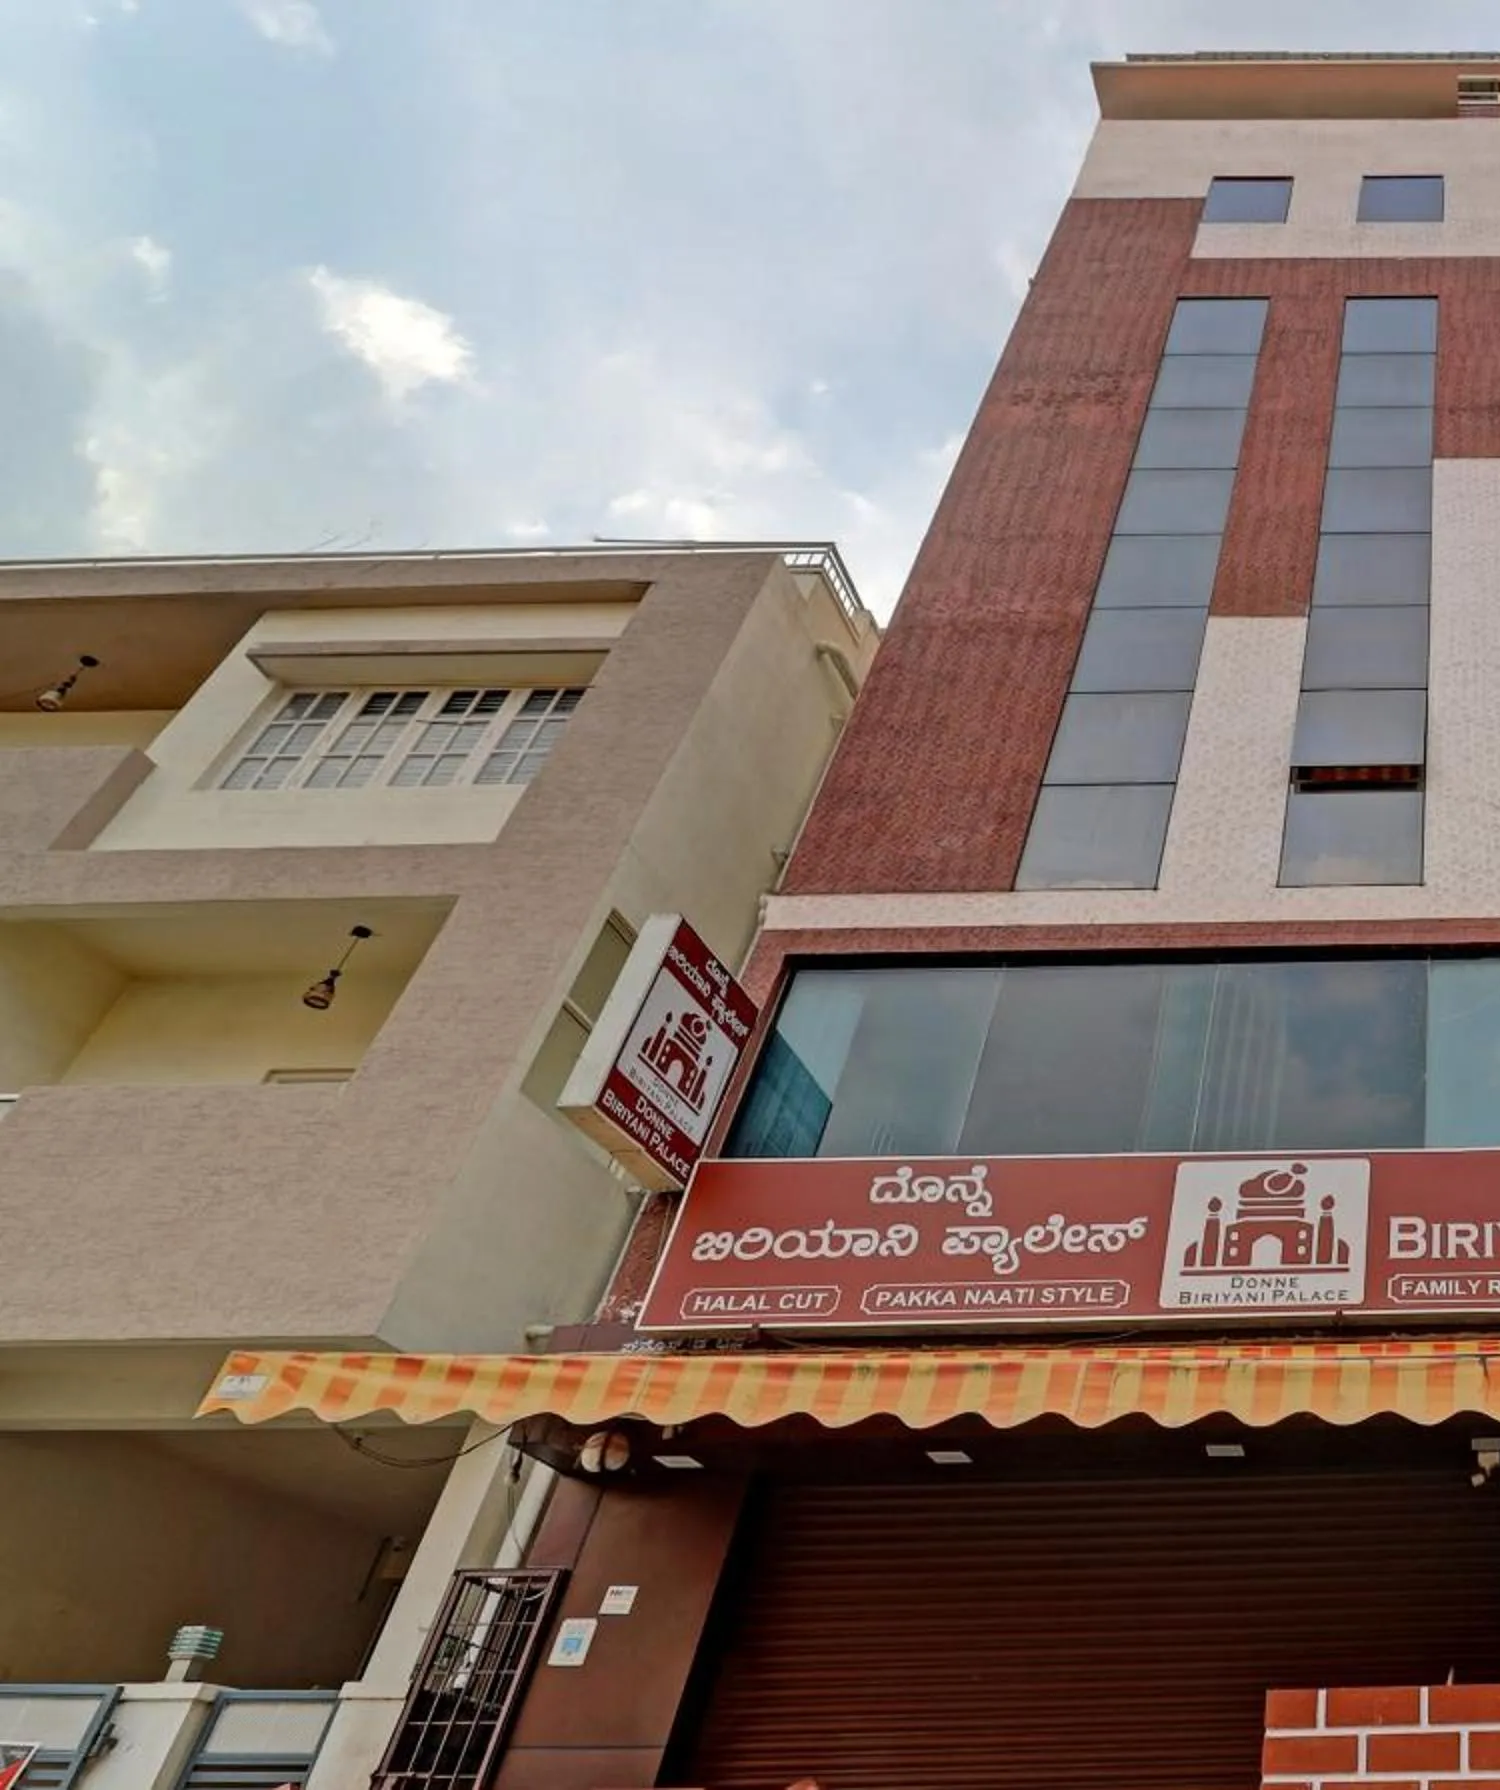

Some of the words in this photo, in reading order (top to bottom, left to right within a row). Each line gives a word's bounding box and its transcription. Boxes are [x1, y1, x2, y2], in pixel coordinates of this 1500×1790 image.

[636, 1096, 675, 1140] DONNE
[602, 1089, 651, 1141] BIRIYANI
[648, 1132, 691, 1178] PALACE
[869, 1165, 993, 1218] ದೊನ್ನೆ
[691, 1218, 919, 1261] ಬಿರಿಯಾನಿ
[942, 1213, 1148, 1275] ಪ್ಯಾಲೇಸ್
[1231, 1275, 1300, 1290] DONNE
[1400, 1279, 1481, 1296] FAMILY
[693, 1293, 771, 1312] HALAL
[779, 1292, 828, 1309] CUT
[875, 1290, 956, 1308] PAKKA
[964, 1287, 1035, 1306] NAATI
[1040, 1286, 1115, 1304] STYLE
[1178, 1291, 1266, 1306] BIRIYANI
[1272, 1288, 1349, 1303] PALACE
